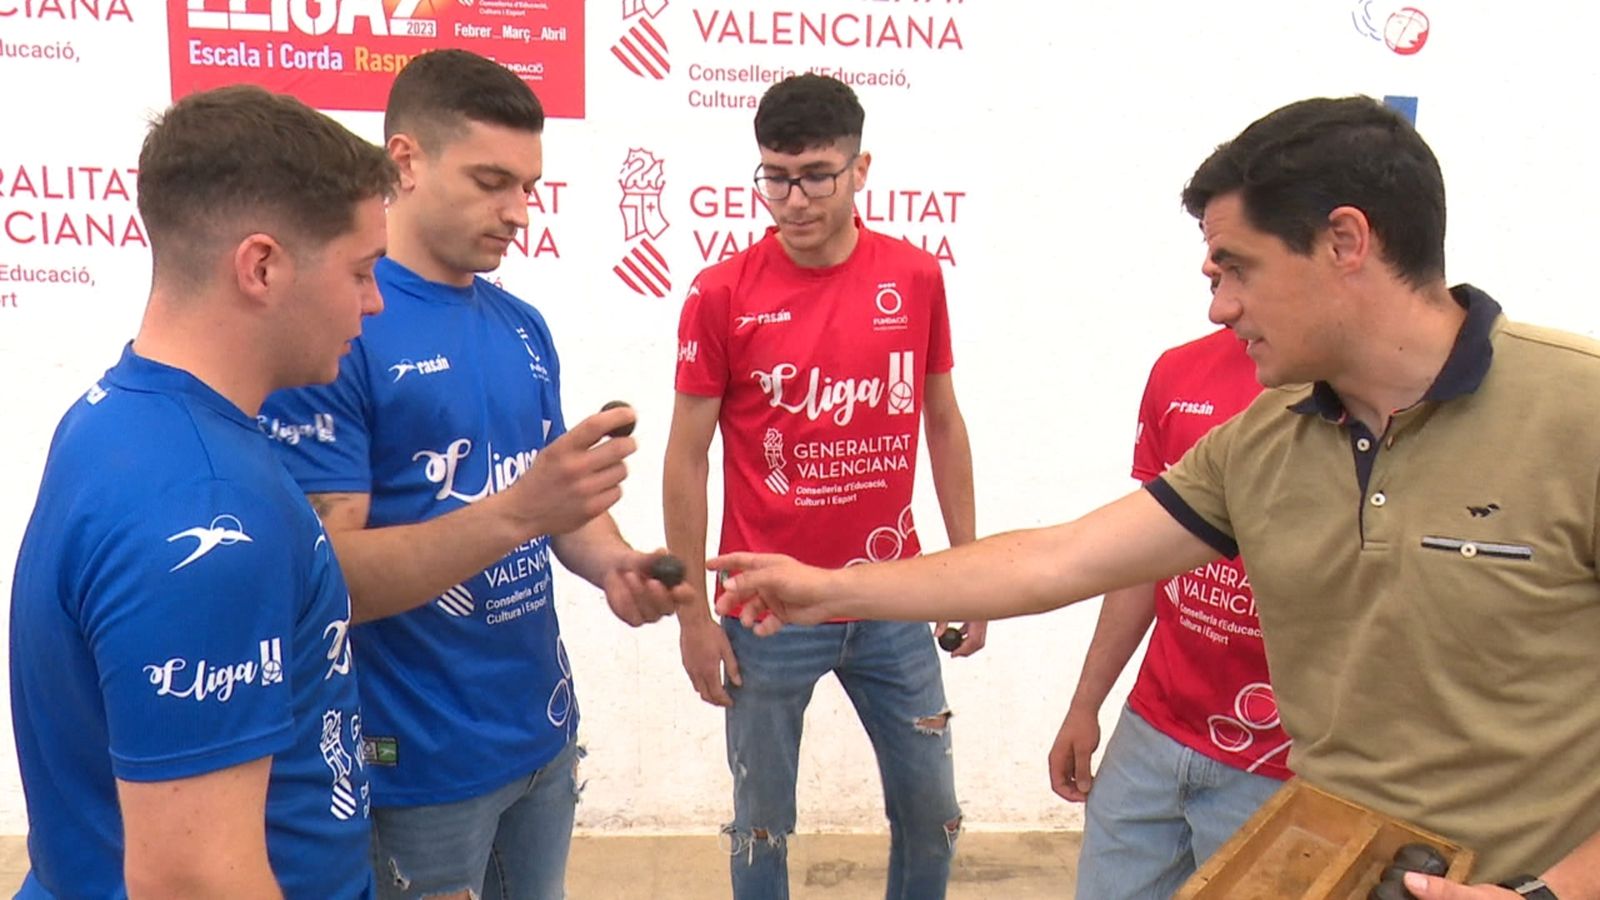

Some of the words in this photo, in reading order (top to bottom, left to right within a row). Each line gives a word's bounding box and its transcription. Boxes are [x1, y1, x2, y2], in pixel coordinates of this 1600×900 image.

[406, 21, 434, 35] 2023
[454, 22, 492, 38] Febrer
[502, 25, 531, 43] Març
[541, 27, 566, 41] Abril
[693, 9, 963, 50] VALENCIANA
[189, 40, 260, 68] Escala
[266, 43, 274, 69] i
[279, 43, 343, 71] Corda
[355, 46, 436, 76] Rasp
[688, 90, 757, 109] Cultura
[415, 354, 450, 375] rasán
[751, 363, 885, 426] Lliga
[793, 434, 911, 459] GENERALITAT
[796, 455, 909, 479] VALENCIANA
[794, 496, 825, 507] Cultura
[832, 493, 857, 506] Esport
[796, 485, 842, 495] Conselleria
[142, 658, 258, 702] Lliga
